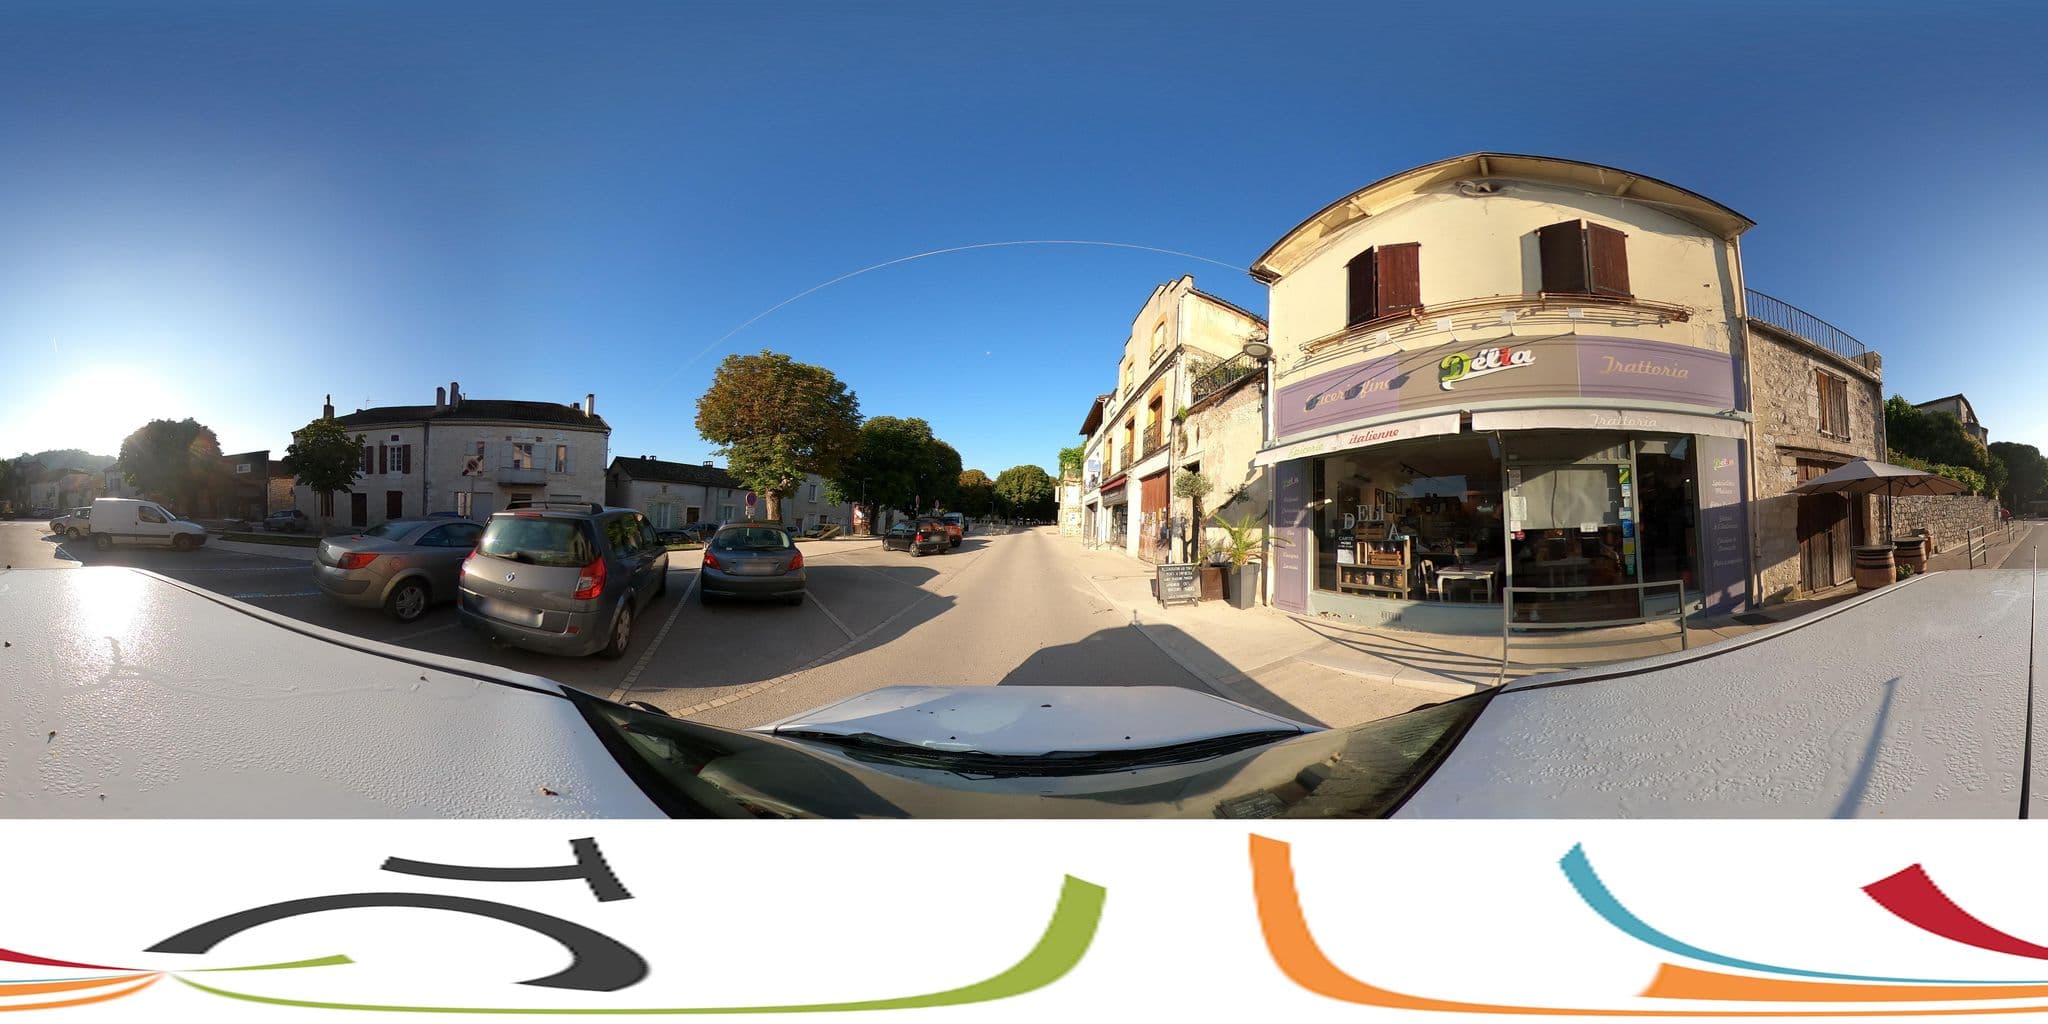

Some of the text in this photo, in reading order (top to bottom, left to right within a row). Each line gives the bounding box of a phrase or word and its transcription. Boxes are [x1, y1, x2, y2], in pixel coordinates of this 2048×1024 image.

[1599, 356, 1689, 379] Trattoria
[1591, 413, 1657, 427] Trattoria
[1348, 428, 1400, 445] italienne
